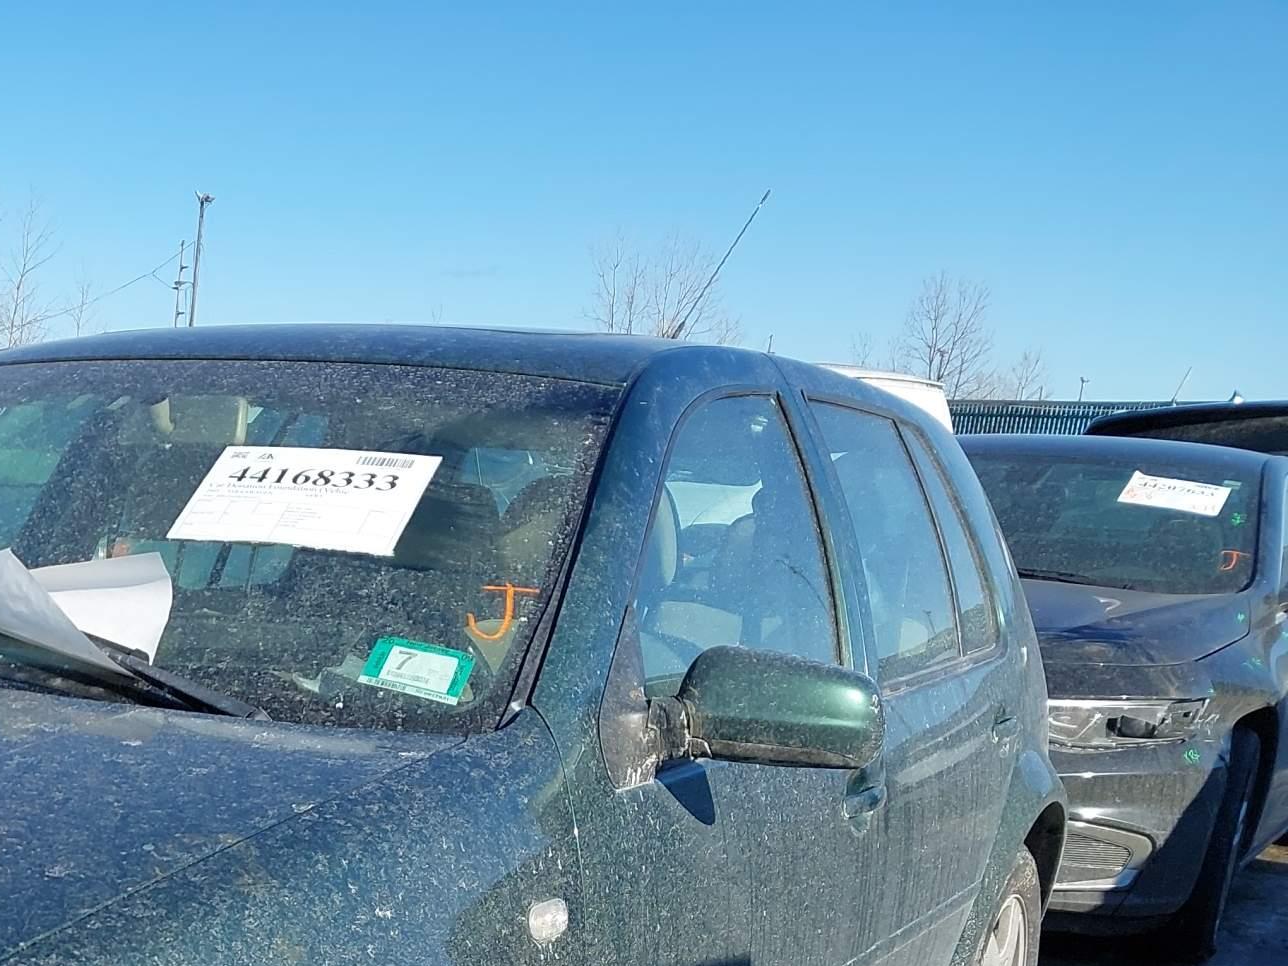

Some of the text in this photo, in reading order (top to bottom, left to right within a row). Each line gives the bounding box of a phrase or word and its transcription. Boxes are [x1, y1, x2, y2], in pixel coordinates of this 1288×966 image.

[228, 466, 400, 492] 44168333
[467, 583, 541, 641] J
[397, 649, 418, 670] 7
